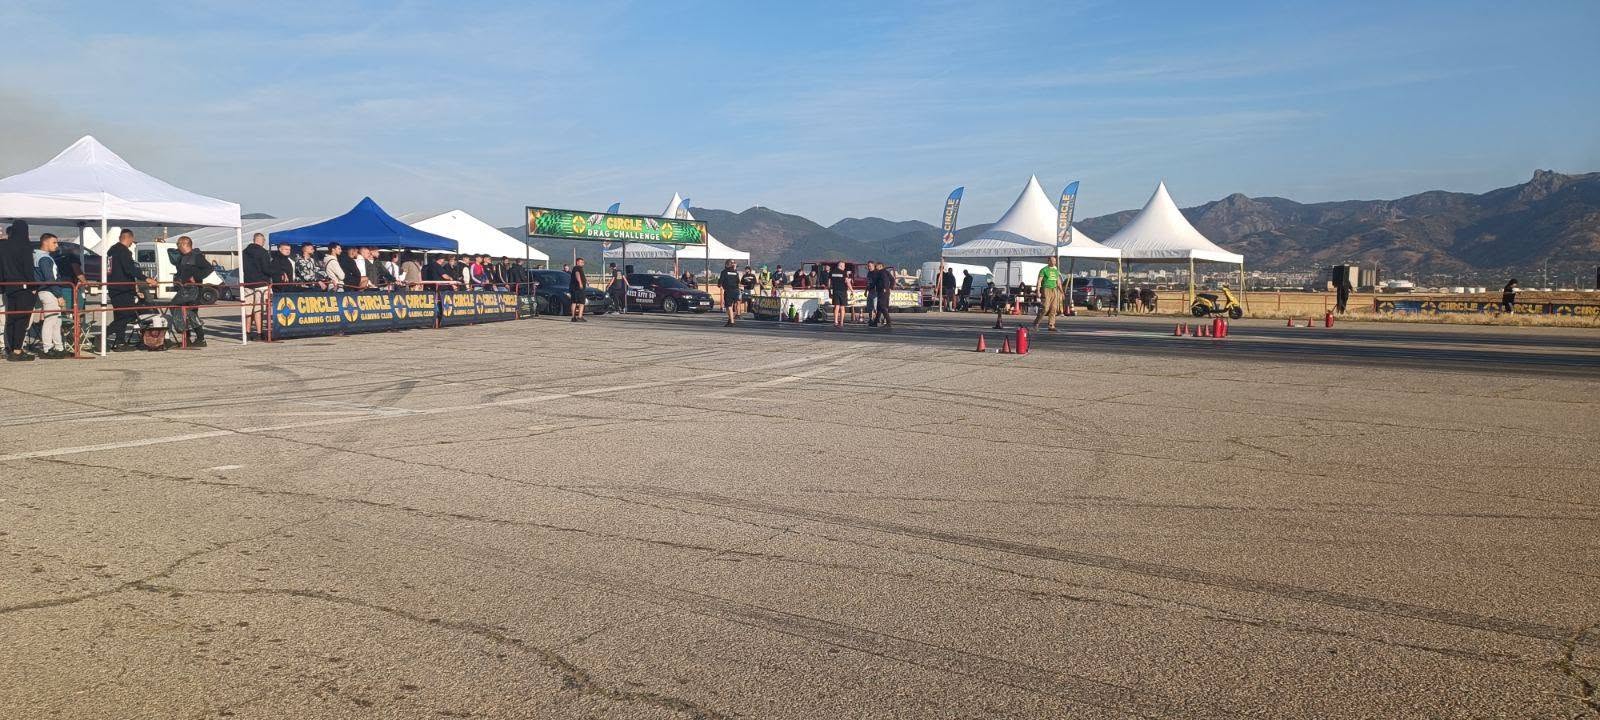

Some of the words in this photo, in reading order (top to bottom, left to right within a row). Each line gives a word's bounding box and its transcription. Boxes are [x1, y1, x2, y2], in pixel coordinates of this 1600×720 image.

[944, 198, 955, 231] CIRCLE
[1059, 194, 1070, 229] CIRCLE
[606, 217, 643, 231] CIRCLE
[587, 229, 610, 238] DRAG
[613, 231, 660, 241] CHALLENGE
[297, 296, 339, 314] CIRCLE
[357, 295, 391, 310] CIRCLE
[406, 294, 435, 309] CIRCLE
[453, 294, 475, 307] CIRCLE
[1438, 302, 1478, 311] CIRCLE
[299, 316, 324, 325] GAMING
[325, 315, 341, 323] CLUB
[361, 313, 380, 321] GAMING
